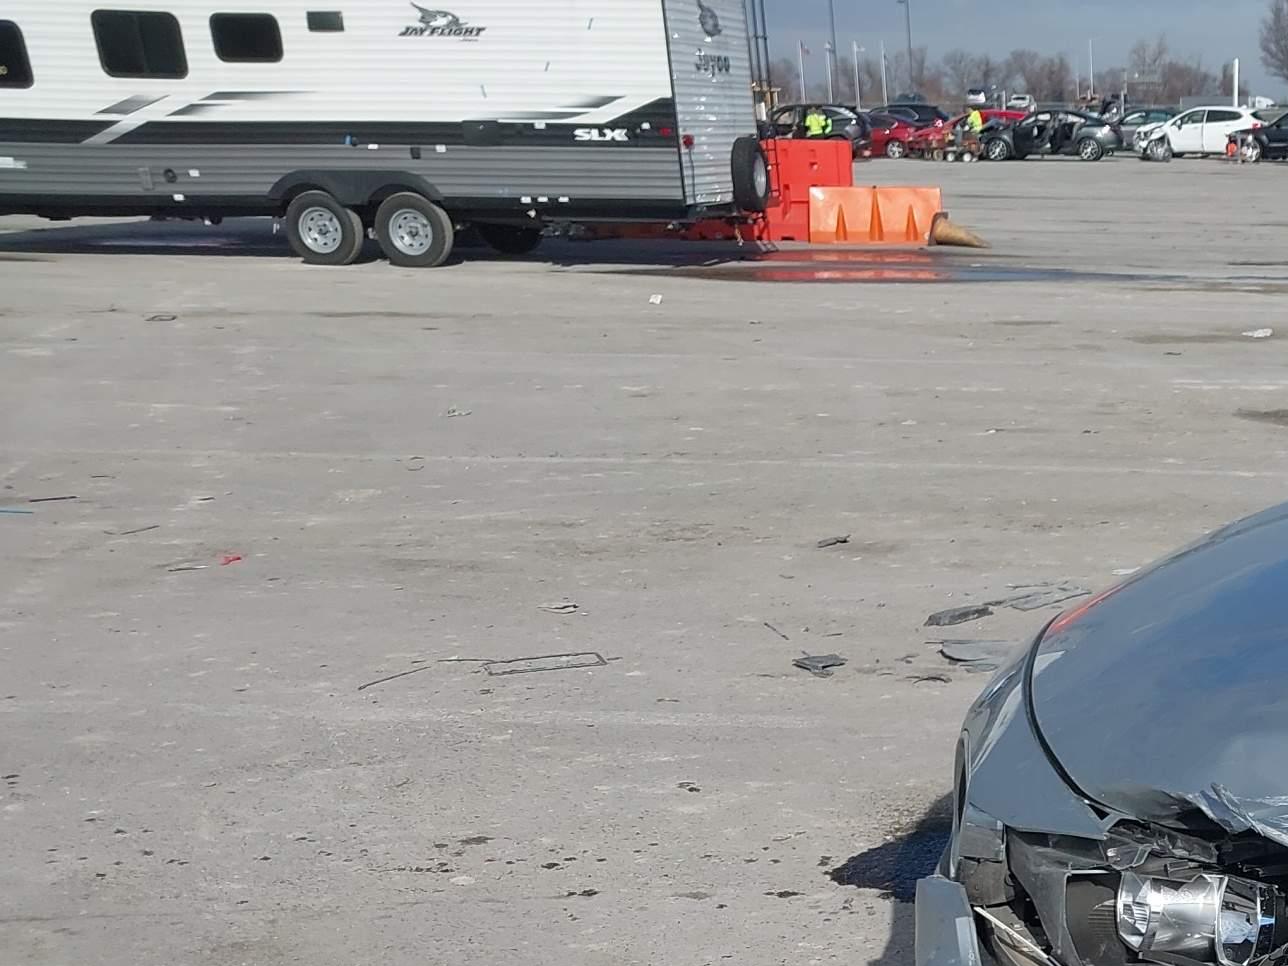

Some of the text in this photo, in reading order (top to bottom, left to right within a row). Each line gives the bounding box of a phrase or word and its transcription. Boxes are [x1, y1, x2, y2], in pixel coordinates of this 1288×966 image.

[398, 27, 486, 36] JAY FLIGHT
[573, 128, 629, 141] SLX
